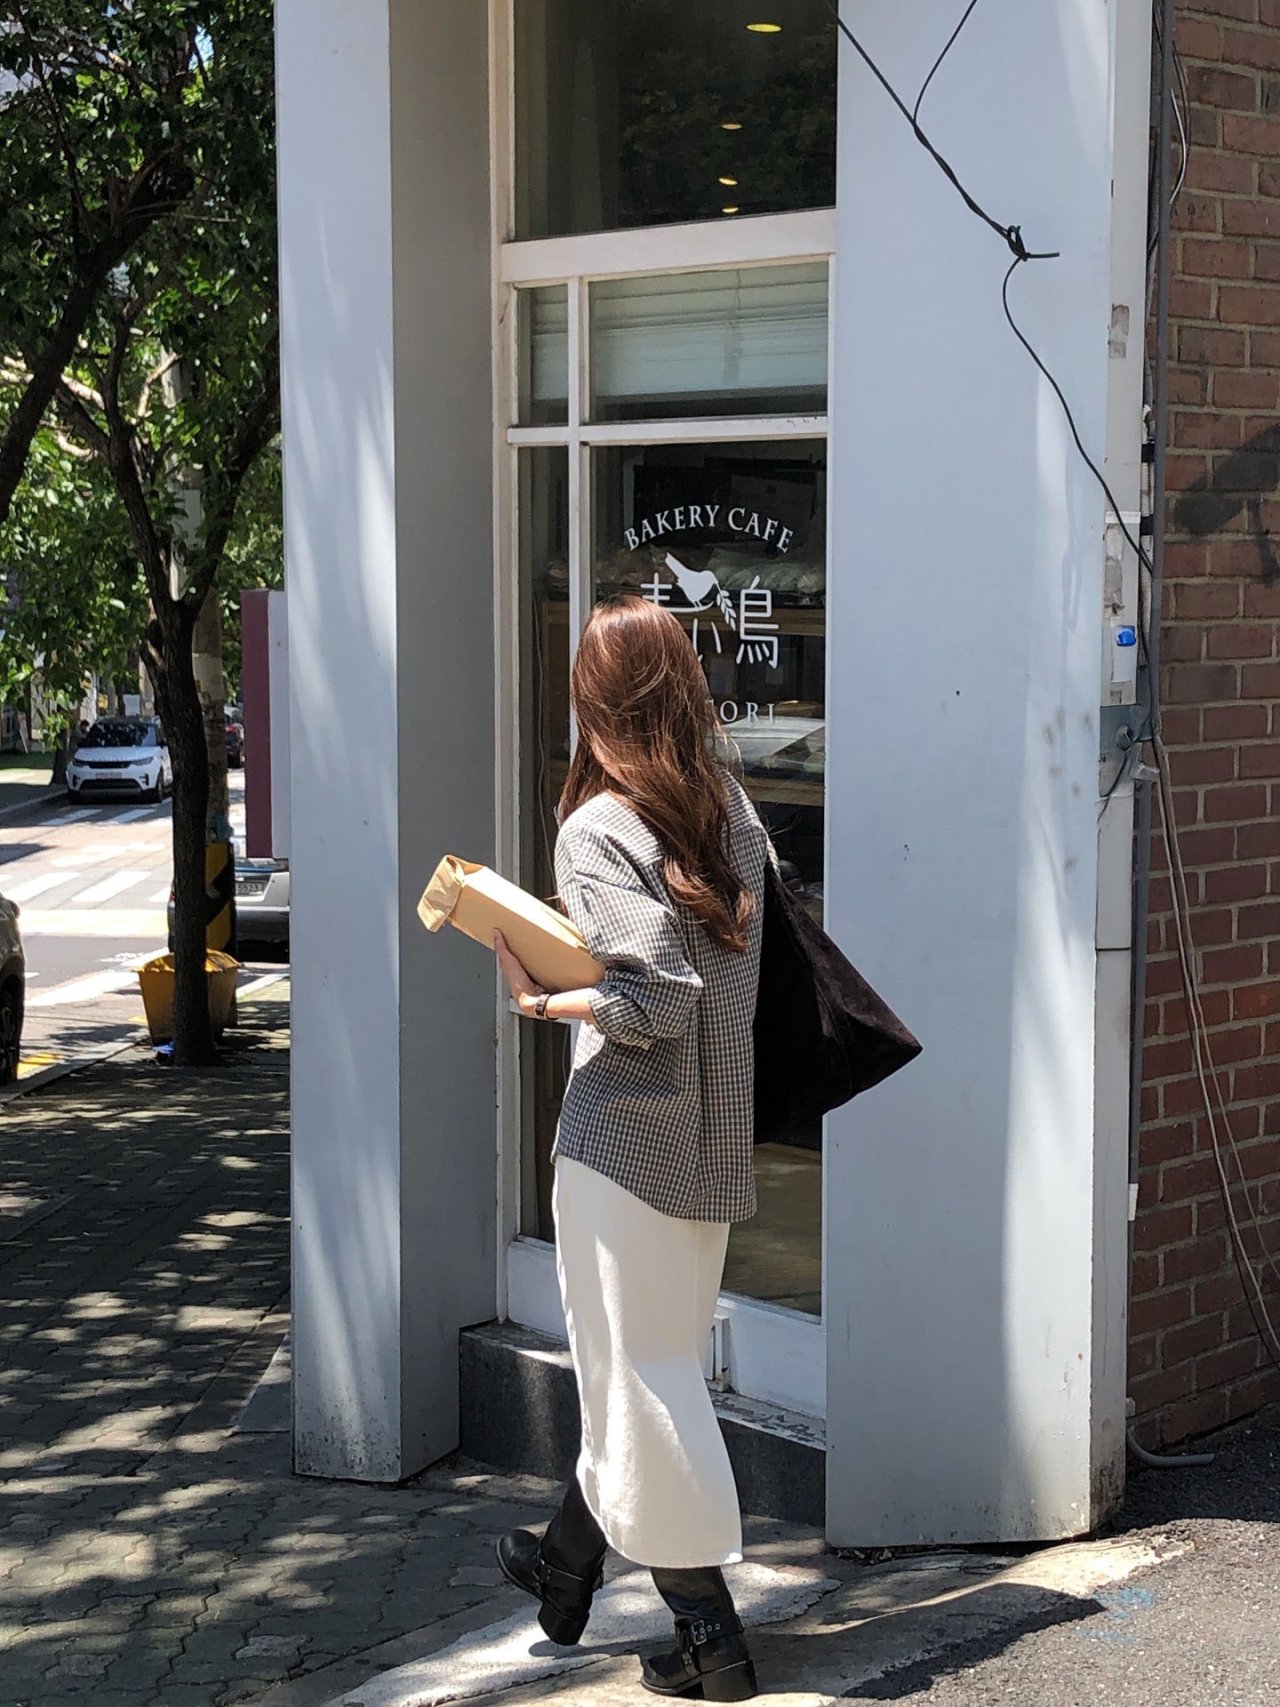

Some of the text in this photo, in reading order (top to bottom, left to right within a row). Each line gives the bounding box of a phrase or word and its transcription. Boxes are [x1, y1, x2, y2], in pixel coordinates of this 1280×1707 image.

[624, 504, 793, 553] BAKERY CAFE
[705, 699, 775, 722] ORI
